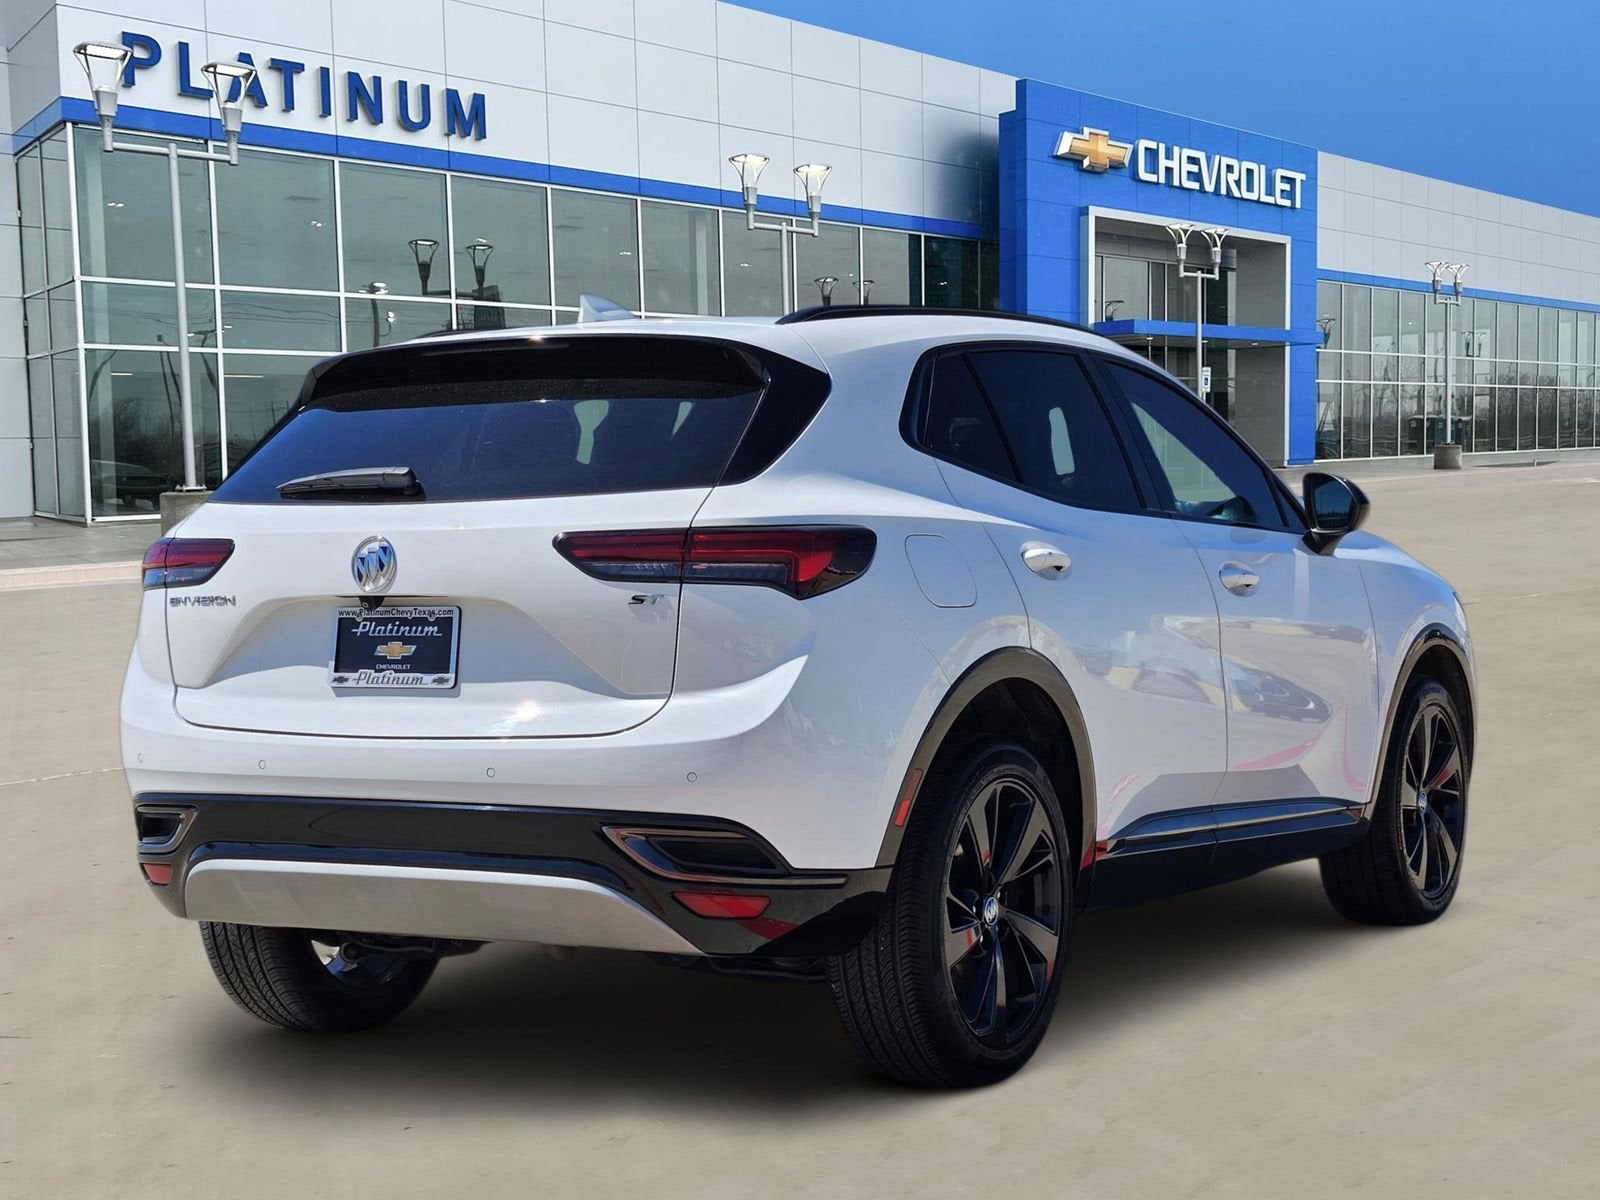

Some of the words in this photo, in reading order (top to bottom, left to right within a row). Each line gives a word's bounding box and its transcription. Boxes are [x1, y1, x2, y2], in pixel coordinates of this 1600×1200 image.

[121, 31, 487, 141] PLATINUM
[1137, 138, 1306, 209] CHEVROLET
[170, 596, 236, 607] ENVISION
[628, 594, 666, 605] ST
[338, 607, 454, 617] www.PlatinumChevyTexas.com
[352, 621, 443, 637] Platinum
[353, 670, 429, 686] Platinum
